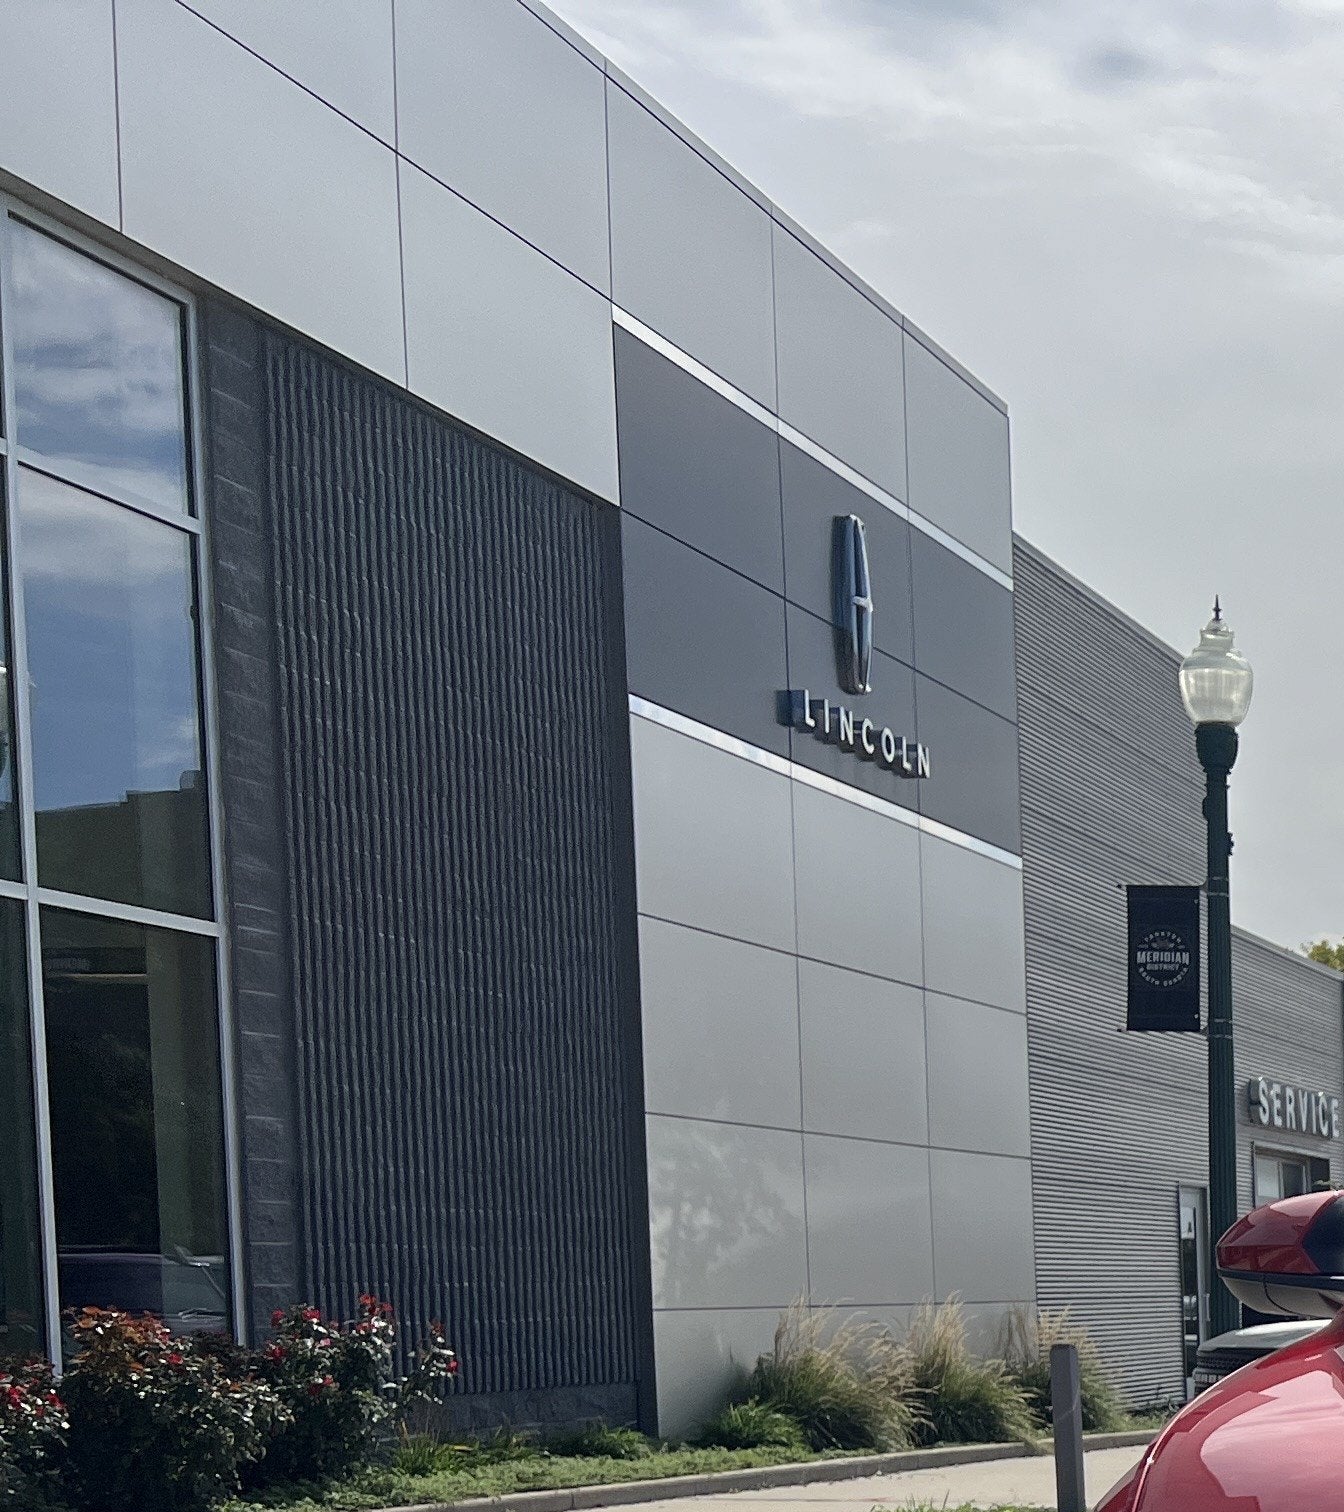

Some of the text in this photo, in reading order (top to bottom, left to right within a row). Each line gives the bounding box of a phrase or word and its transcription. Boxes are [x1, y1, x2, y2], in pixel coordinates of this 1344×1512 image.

[803, 688, 931, 779] LINCOLN
[1136, 951, 1190, 965] MERIDIAN
[1257, 1077, 1340, 1138] SERVICE
